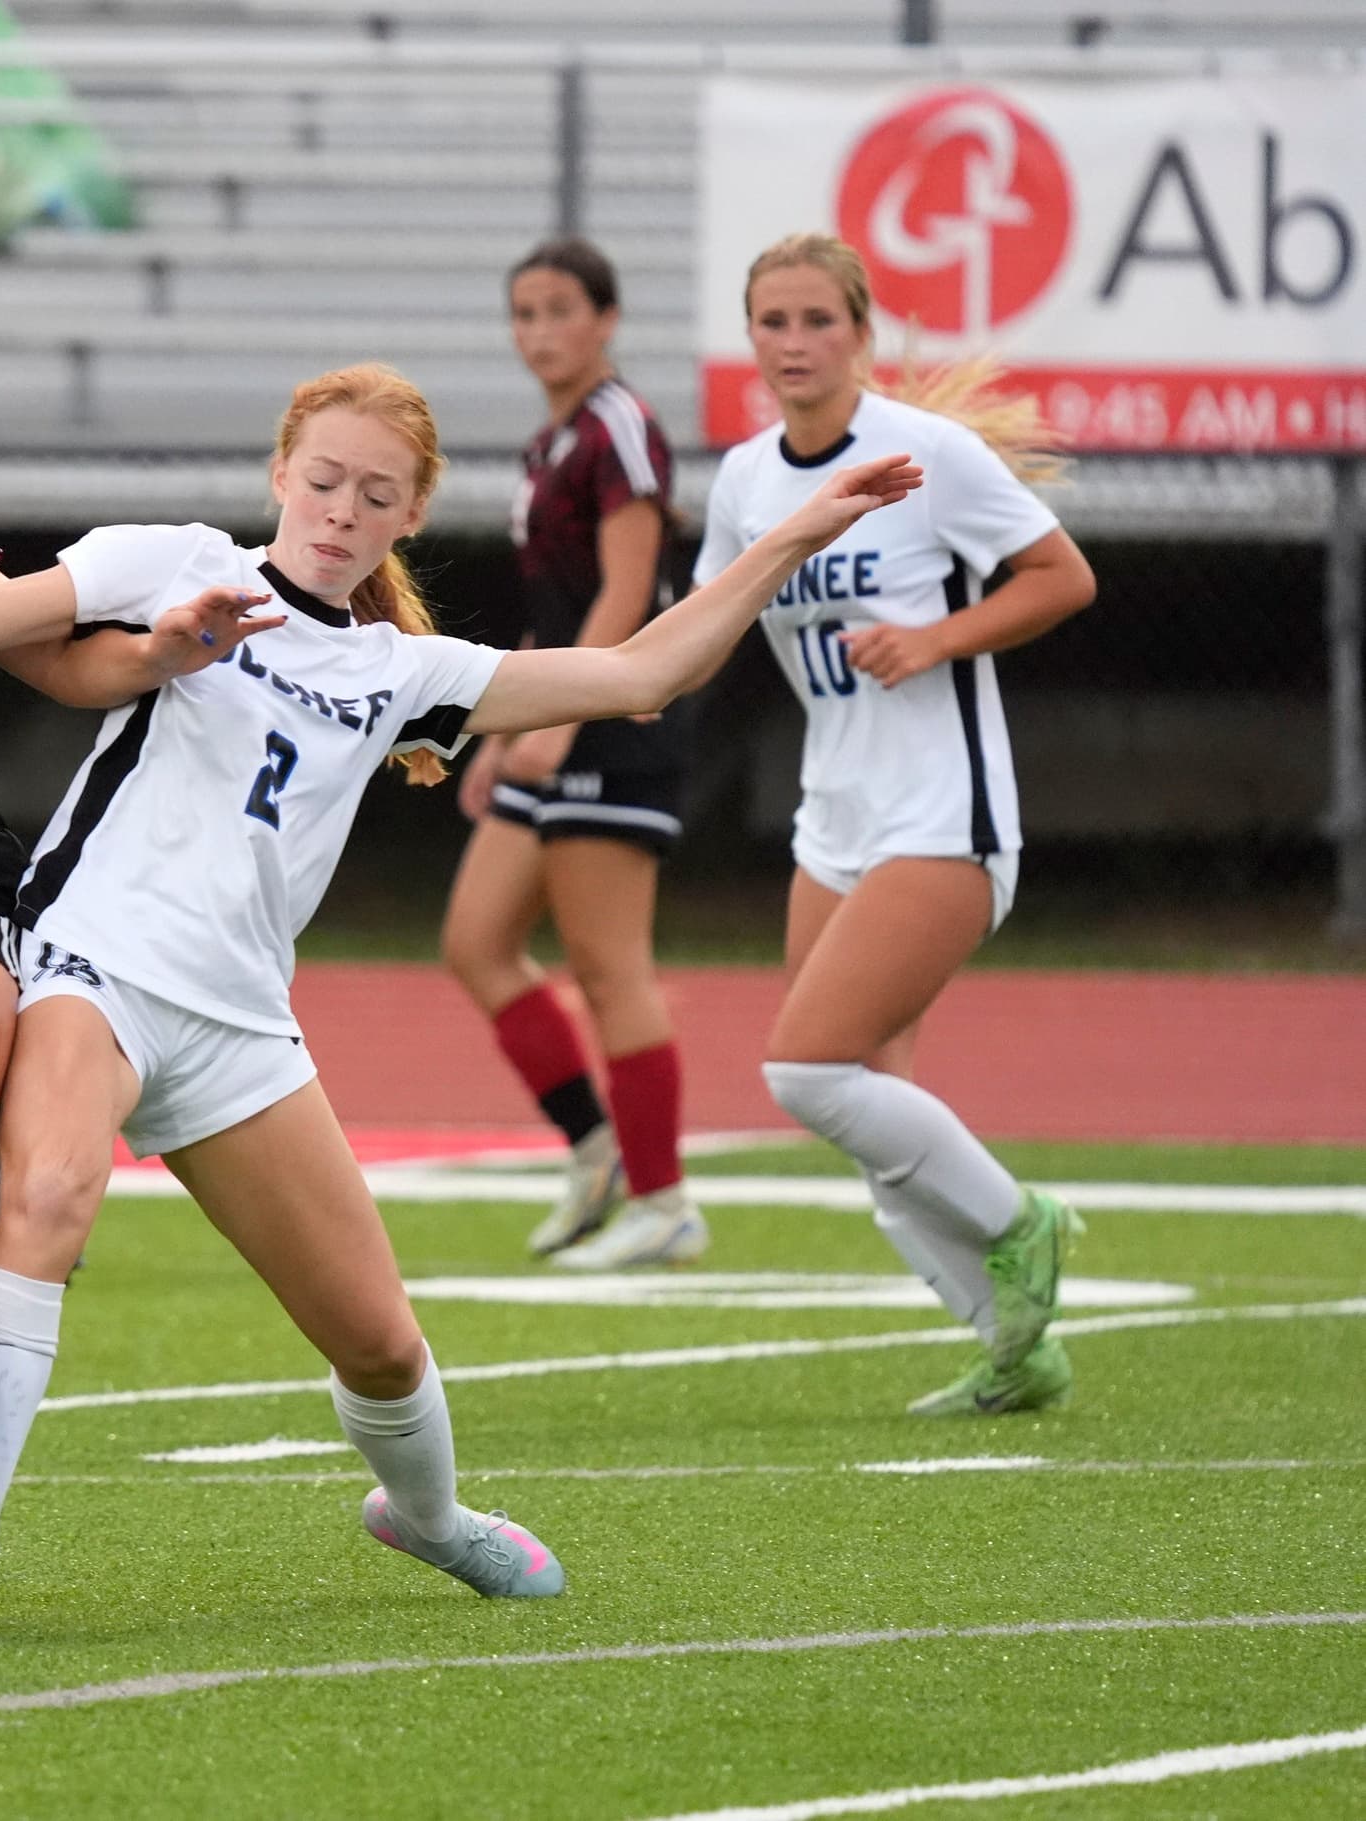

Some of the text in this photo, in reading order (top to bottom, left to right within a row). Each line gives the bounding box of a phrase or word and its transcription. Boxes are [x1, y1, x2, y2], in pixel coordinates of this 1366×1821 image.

[1097, 132, 1355, 305] Ab
[1177, 380, 1278, 446] AM
[797, 619, 857, 697] 10
[244, 729, 299, 832] 2
